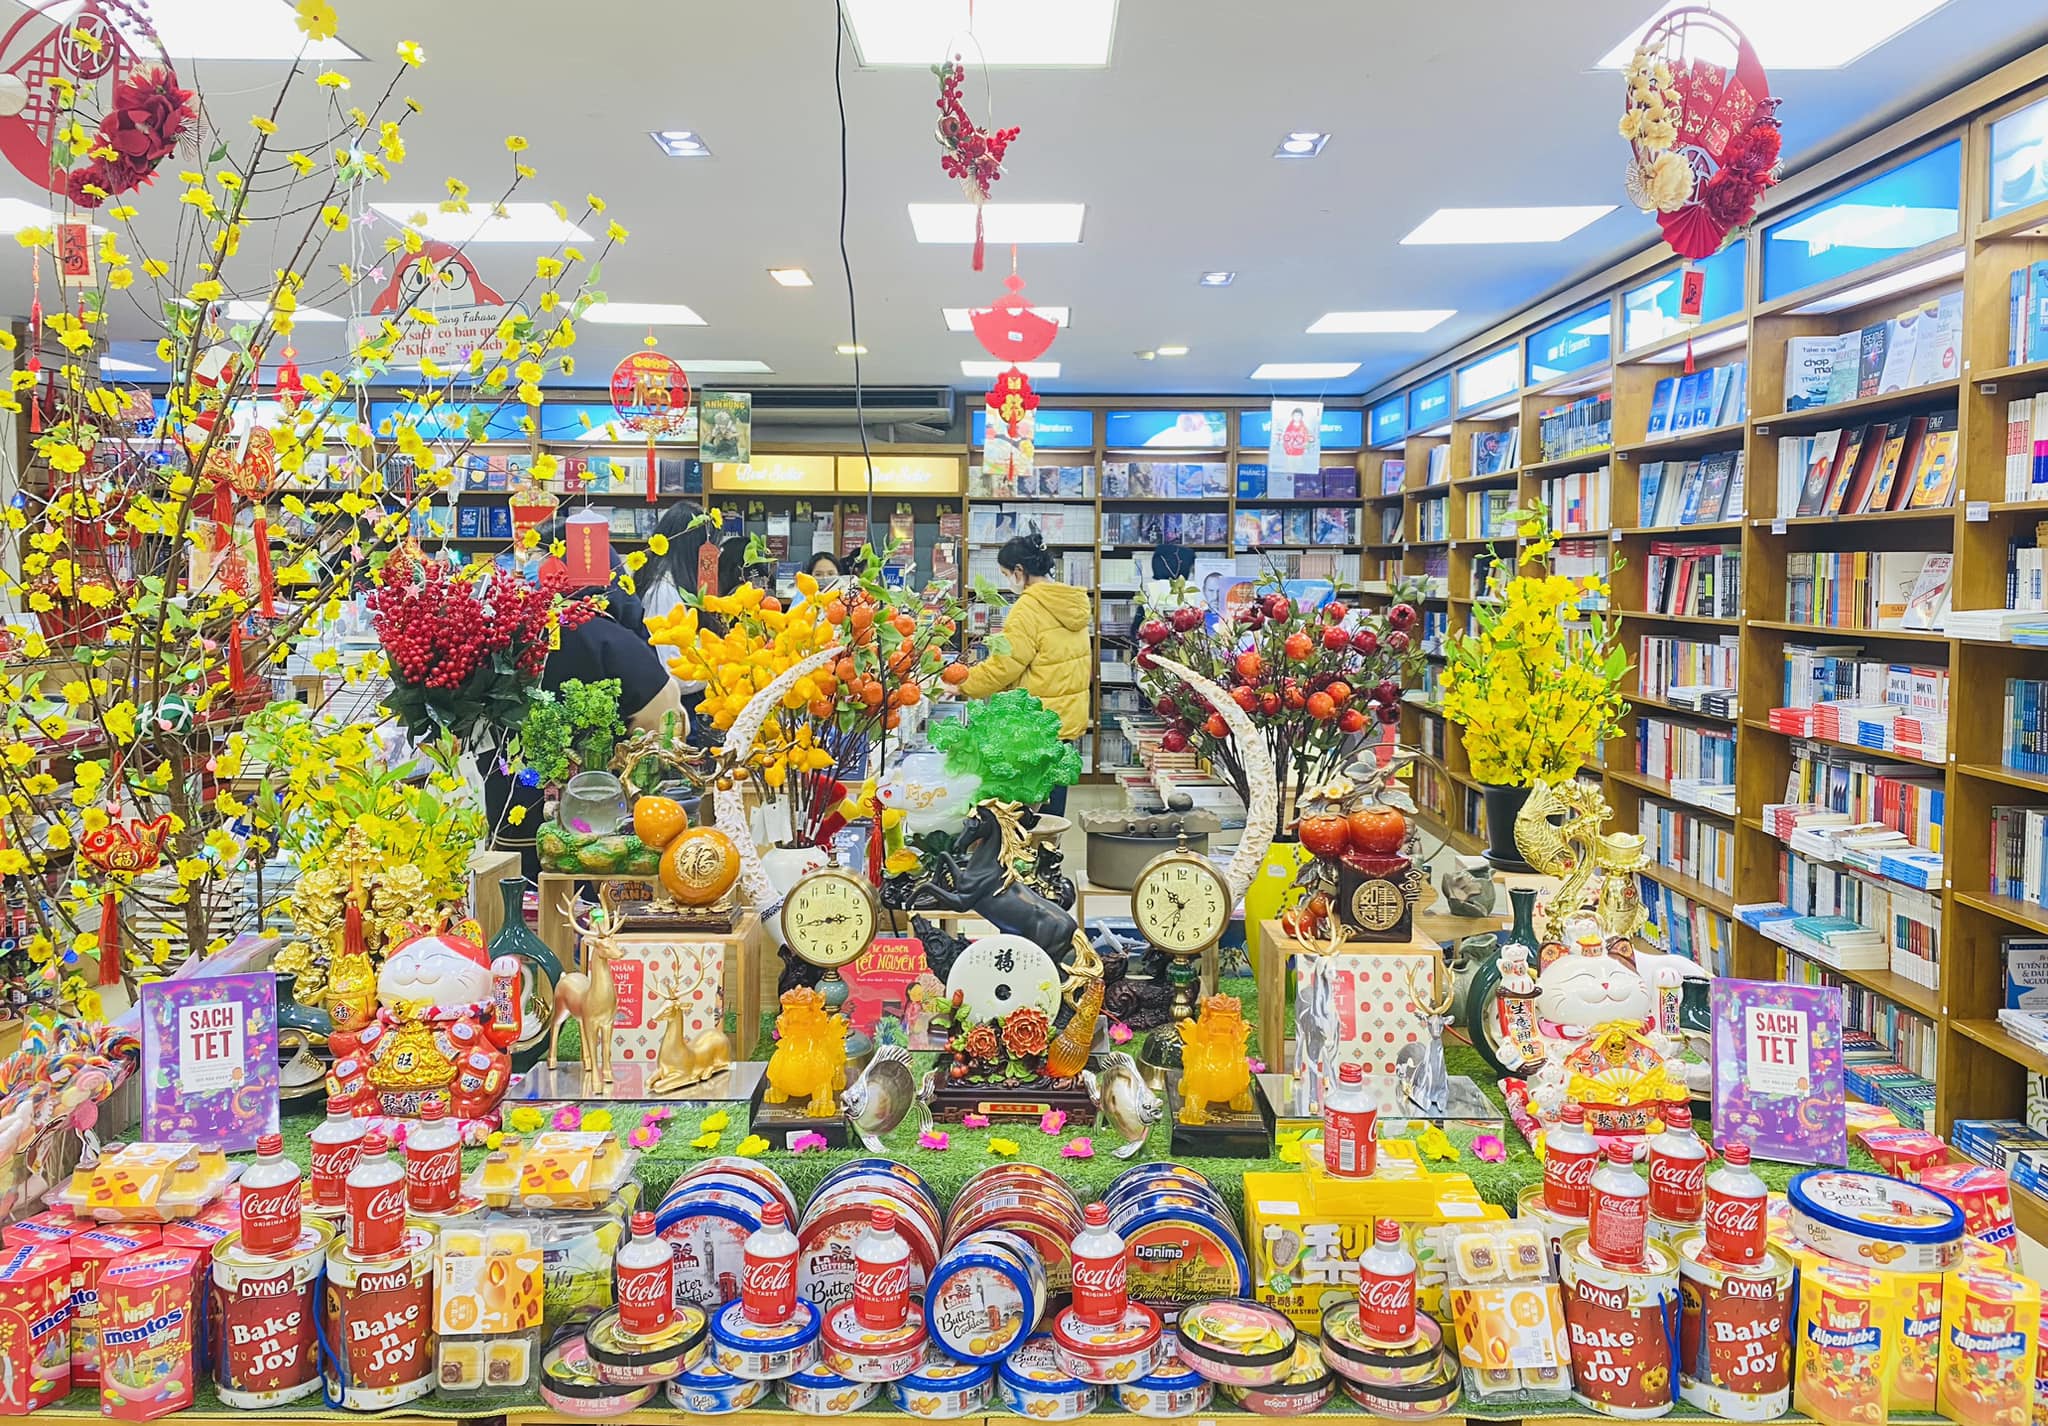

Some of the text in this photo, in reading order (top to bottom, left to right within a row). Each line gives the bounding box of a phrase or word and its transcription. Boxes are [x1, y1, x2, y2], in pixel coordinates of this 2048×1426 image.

[1178, 869, 1187, 880] 12
[826, 884, 835, 894] 12
[1151, 883, 1159, 894] 10
[800, 898, 808, 909] 10
[1147, 898, 1154, 909] 9
[1208, 901, 1215, 912] 3
[796, 913, 803, 924] 9
[856, 914, 863, 925] 3
[1150, 914, 1158, 925] 8
[1204, 917, 1210, 928] 4
[800, 929, 807, 939] 8
[852, 930, 859, 940] 4
[1162, 926, 1169, 937] 7
[1177, 930, 1184, 942] 6
[1193, 928, 1200, 938] 5
[811, 941, 818, 951] 7
[826, 944, 833, 955] 6
[841, 941, 848, 951] 5
[995, 948, 1014, 973] 福
[398, 1050, 413, 1067] 旺
[1135, 1244, 1183, 1258] Danima
[242, 1279, 288, 1297] DYNA
[361, 1272, 407, 1291] DYNA
[1727, 1279, 1772, 1297] DYNA
[1579, 1285, 1623, 1308] DYNA
[104, 1308, 184, 1345] mentos
[232, 1311, 301, 1345] Bake
[351, 1304, 419, 1342] Bake
[937, 1310, 976, 1333] Butter
[1714, 1315, 1781, 1343] Bake
[380, 1333, 401, 1350] n
[1571, 1322, 1635, 1348] Bake
[1811, 1326, 1876, 1348] Alpenliebe
[1955, 1332, 2021, 1353] Alpenliebe
[260, 1338, 280, 1355] n
[1747, 1341, 1765, 1356] n
[249, 1344, 299, 1376] Joy
[369, 1339, 417, 1372] Joy
[1594, 1348, 1614, 1365] n
[1733, 1351, 1778, 1377] Joy
[1583, 1360, 1633, 1386] Joy
